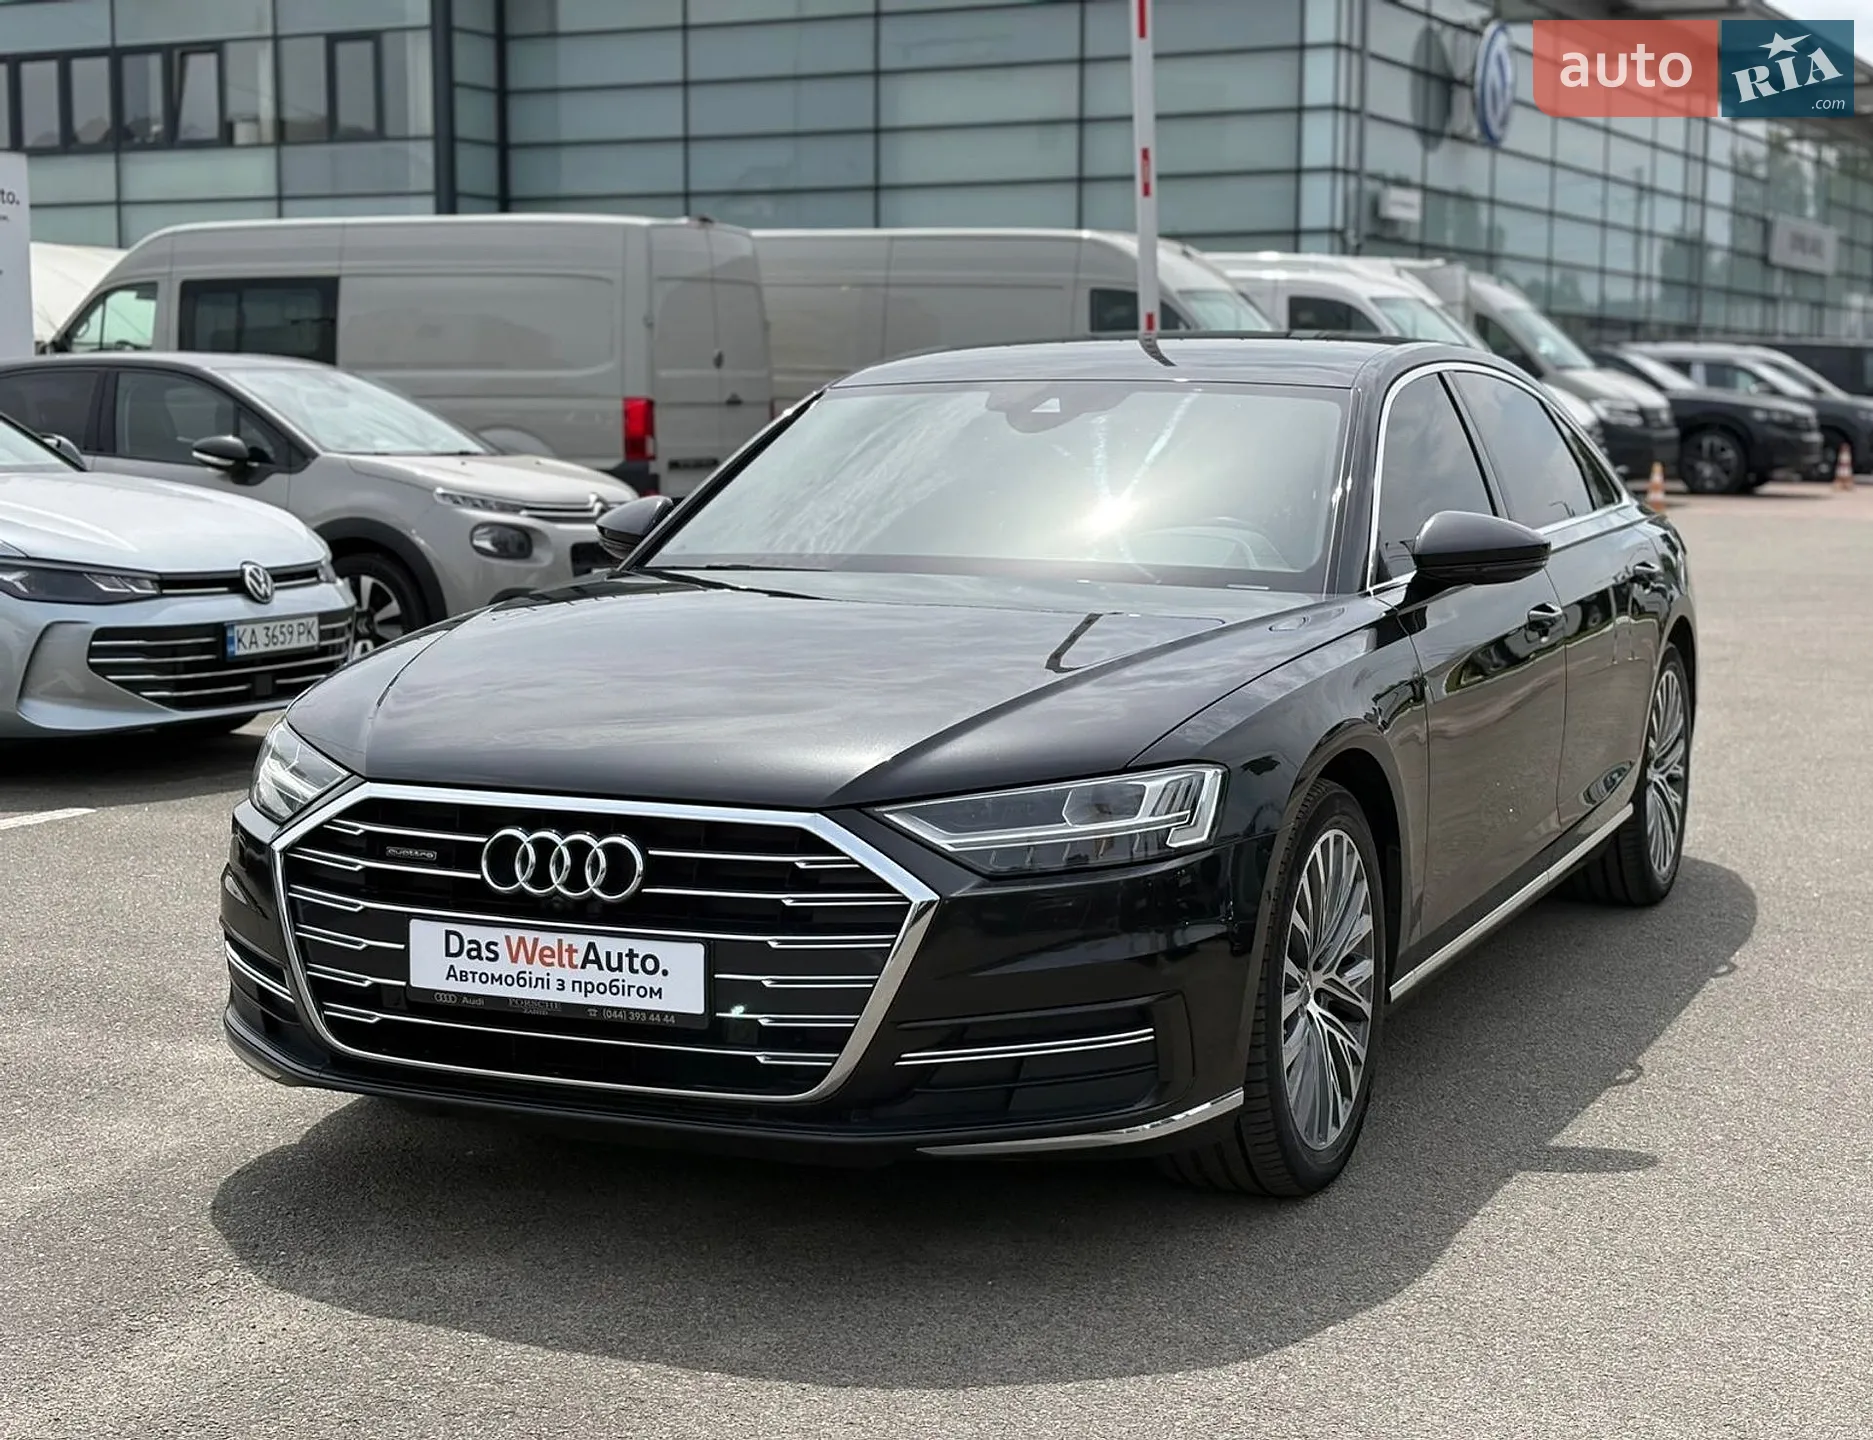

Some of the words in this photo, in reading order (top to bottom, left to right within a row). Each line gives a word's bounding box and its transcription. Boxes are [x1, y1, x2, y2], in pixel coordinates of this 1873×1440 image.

[236, 627, 260, 650] KA
[263, 623, 295, 647] 3659
[297, 620, 317, 643] PK
[444, 929, 500, 962] Das
[445, 964, 551, 990] Автомобілі
[556, 978, 566, 991] з
[571, 977, 663, 1000] пробігом
[461, 996, 485, 1006] Audi
[602, 1008, 627, 1020] (044)
[628, 1011, 647, 1022] 393
[649, 1013, 661, 1023] 44
[663, 1014, 676, 1024] 44
